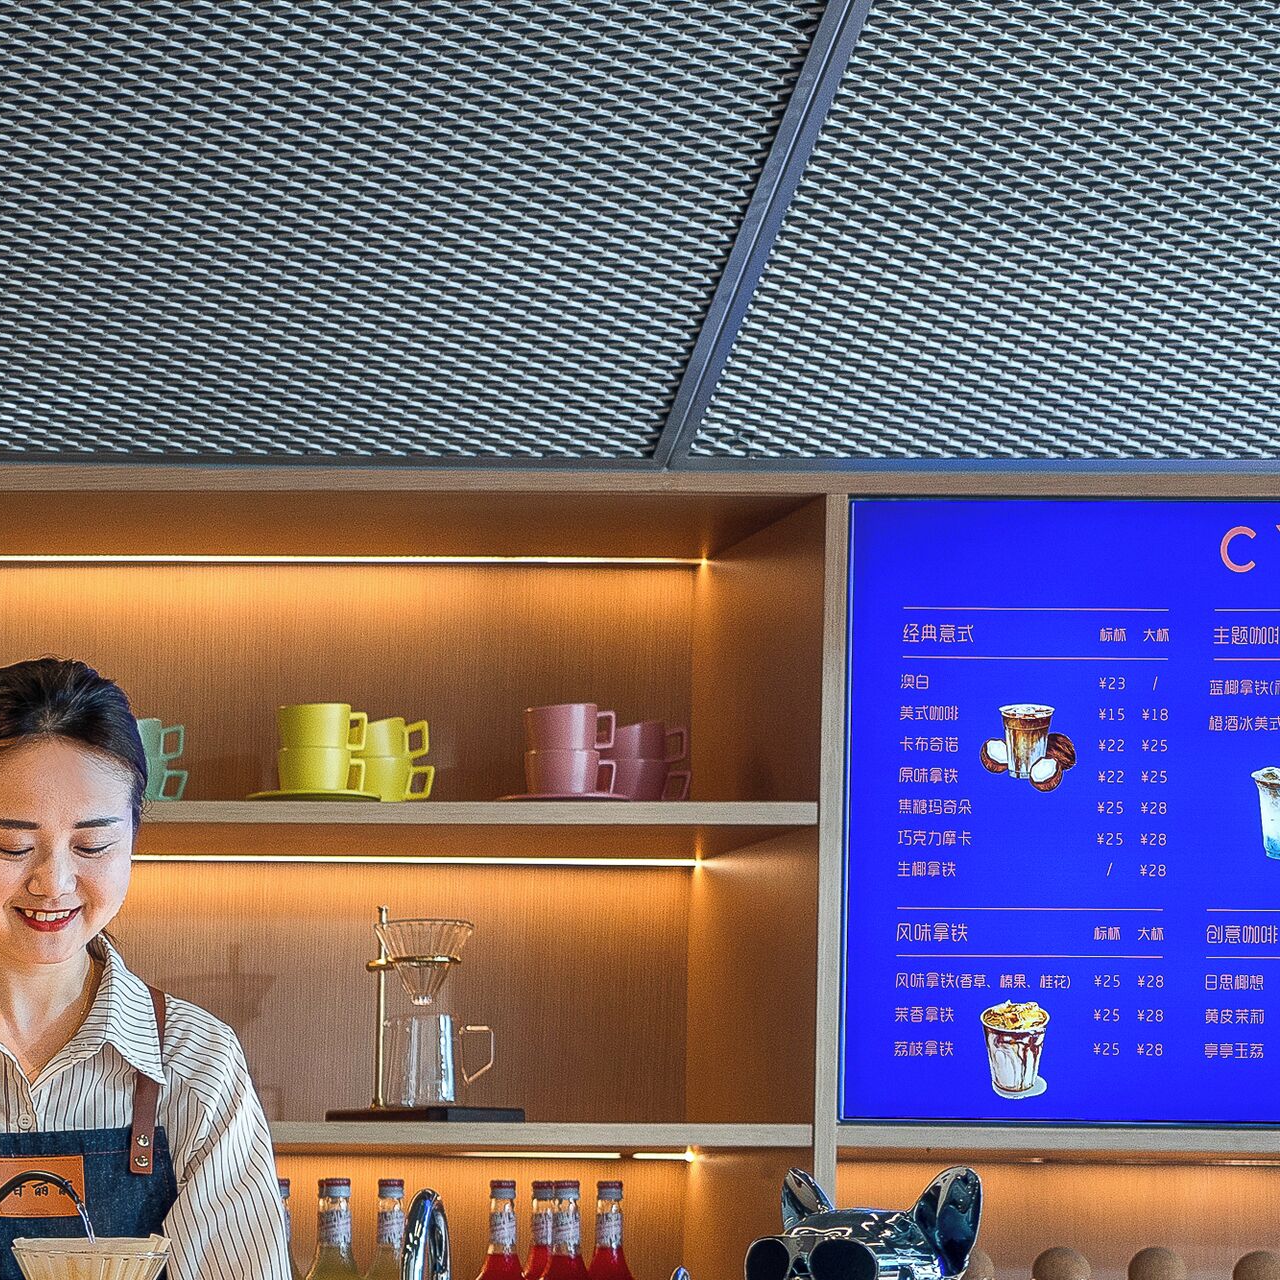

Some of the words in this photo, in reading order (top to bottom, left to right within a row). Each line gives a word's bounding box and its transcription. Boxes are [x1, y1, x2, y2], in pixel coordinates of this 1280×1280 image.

[1219, 524, 1280, 573] C
[902, 623, 974, 643] 经典意式
[1099, 627, 1127, 642] 标杯
[1143, 627, 1170, 642] 大杯
[900, 673, 929, 690] 澳白
[1099, 676, 1126, 690] ¥23
[899, 704, 959, 721] 美式咖啡
[1098, 707, 1125, 721] ¥15
[1142, 708, 1169, 721] ¥18
[899, 735, 959, 753] 卡布奇诺
[1098, 738, 1125, 752] ¥22
[1141, 738, 1168, 753] ¥25
[898, 766, 959, 784] 原味拿铁
[1098, 770, 1125, 783] ¥22
[1141, 770, 1168, 784] ¥25
[898, 798, 972, 815] 焦糖玛奇朵
[1097, 801, 1124, 815] ¥25
[1140, 801, 1167, 815] ¥28
[897, 829, 972, 847] 巧克力摩卡
[1096, 832, 1124, 846] ¥25
[1140, 832, 1167, 847] ¥28
[897, 860, 956, 878] 生椰拿铁
[1140, 863, 1167, 877] ¥28
[896, 922, 968, 943] 风味拿铁
[1093, 926, 1121, 941] 标杯
[1137, 926, 1164, 941] 大杯
[1206, 924, 1279, 944] 创意咖啡
[1094, 974, 1121, 988] ¥25
[1137, 974, 1164, 989] ¥28
[1204, 973, 1264, 991] 日思椰想
[894, 1006, 954, 1023] 茉香拿铁
[1093, 1008, 1120, 1022] ¥25
[1137, 1009, 1164, 1023] ¥28
[1205, 1008, 1265, 1025] 黄皮茉莉
[893, 1040, 954, 1057] 荔枝拿铁
[1093, 1042, 1120, 1056] ¥25
[1136, 1043, 1163, 1057] ¥28
[1204, 1042, 1264, 1059] 亭亭玉荔
